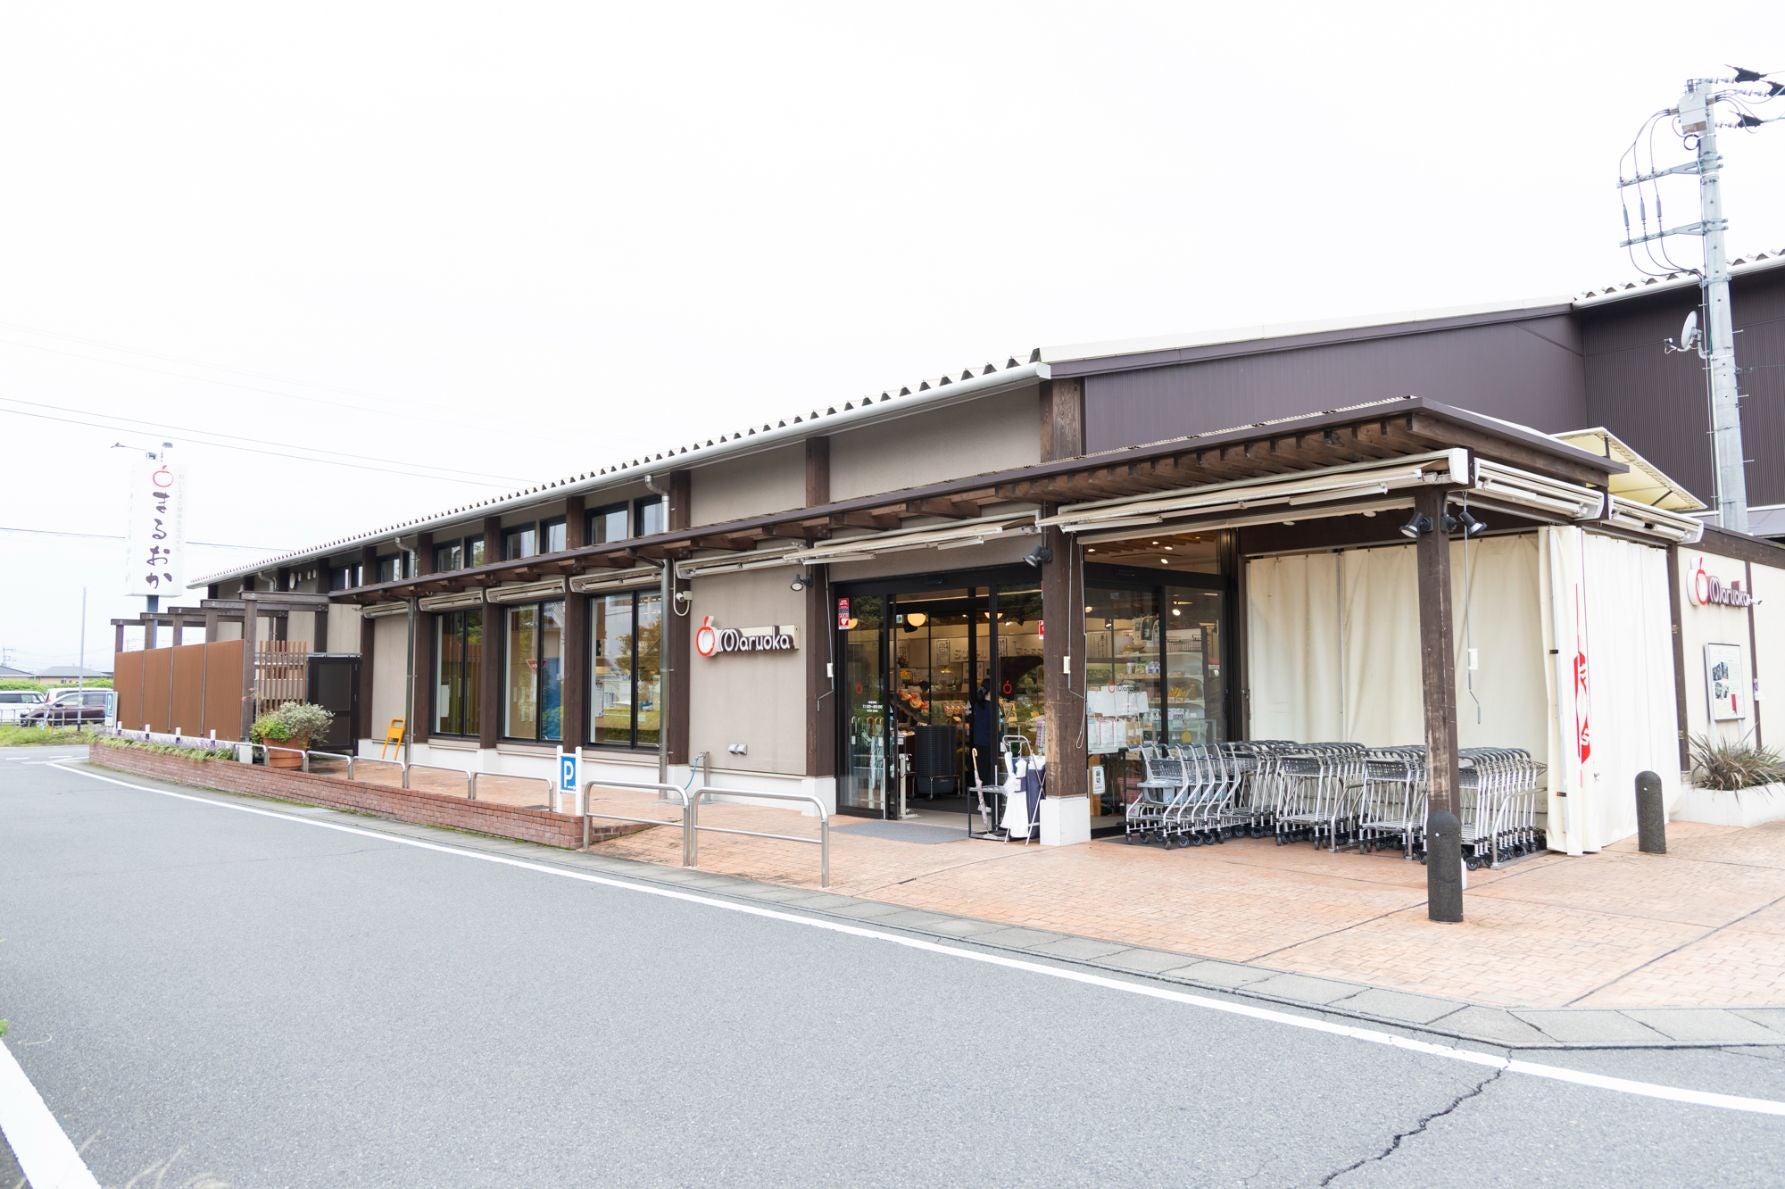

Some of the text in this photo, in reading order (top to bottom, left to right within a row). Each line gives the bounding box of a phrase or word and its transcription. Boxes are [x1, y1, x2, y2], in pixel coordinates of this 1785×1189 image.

[144, 491, 174, 590] まるおか
[1709, 576, 1751, 607] Maruoka
[719, 626, 791, 652] Maruoka
[563, 760, 574, 788] P
